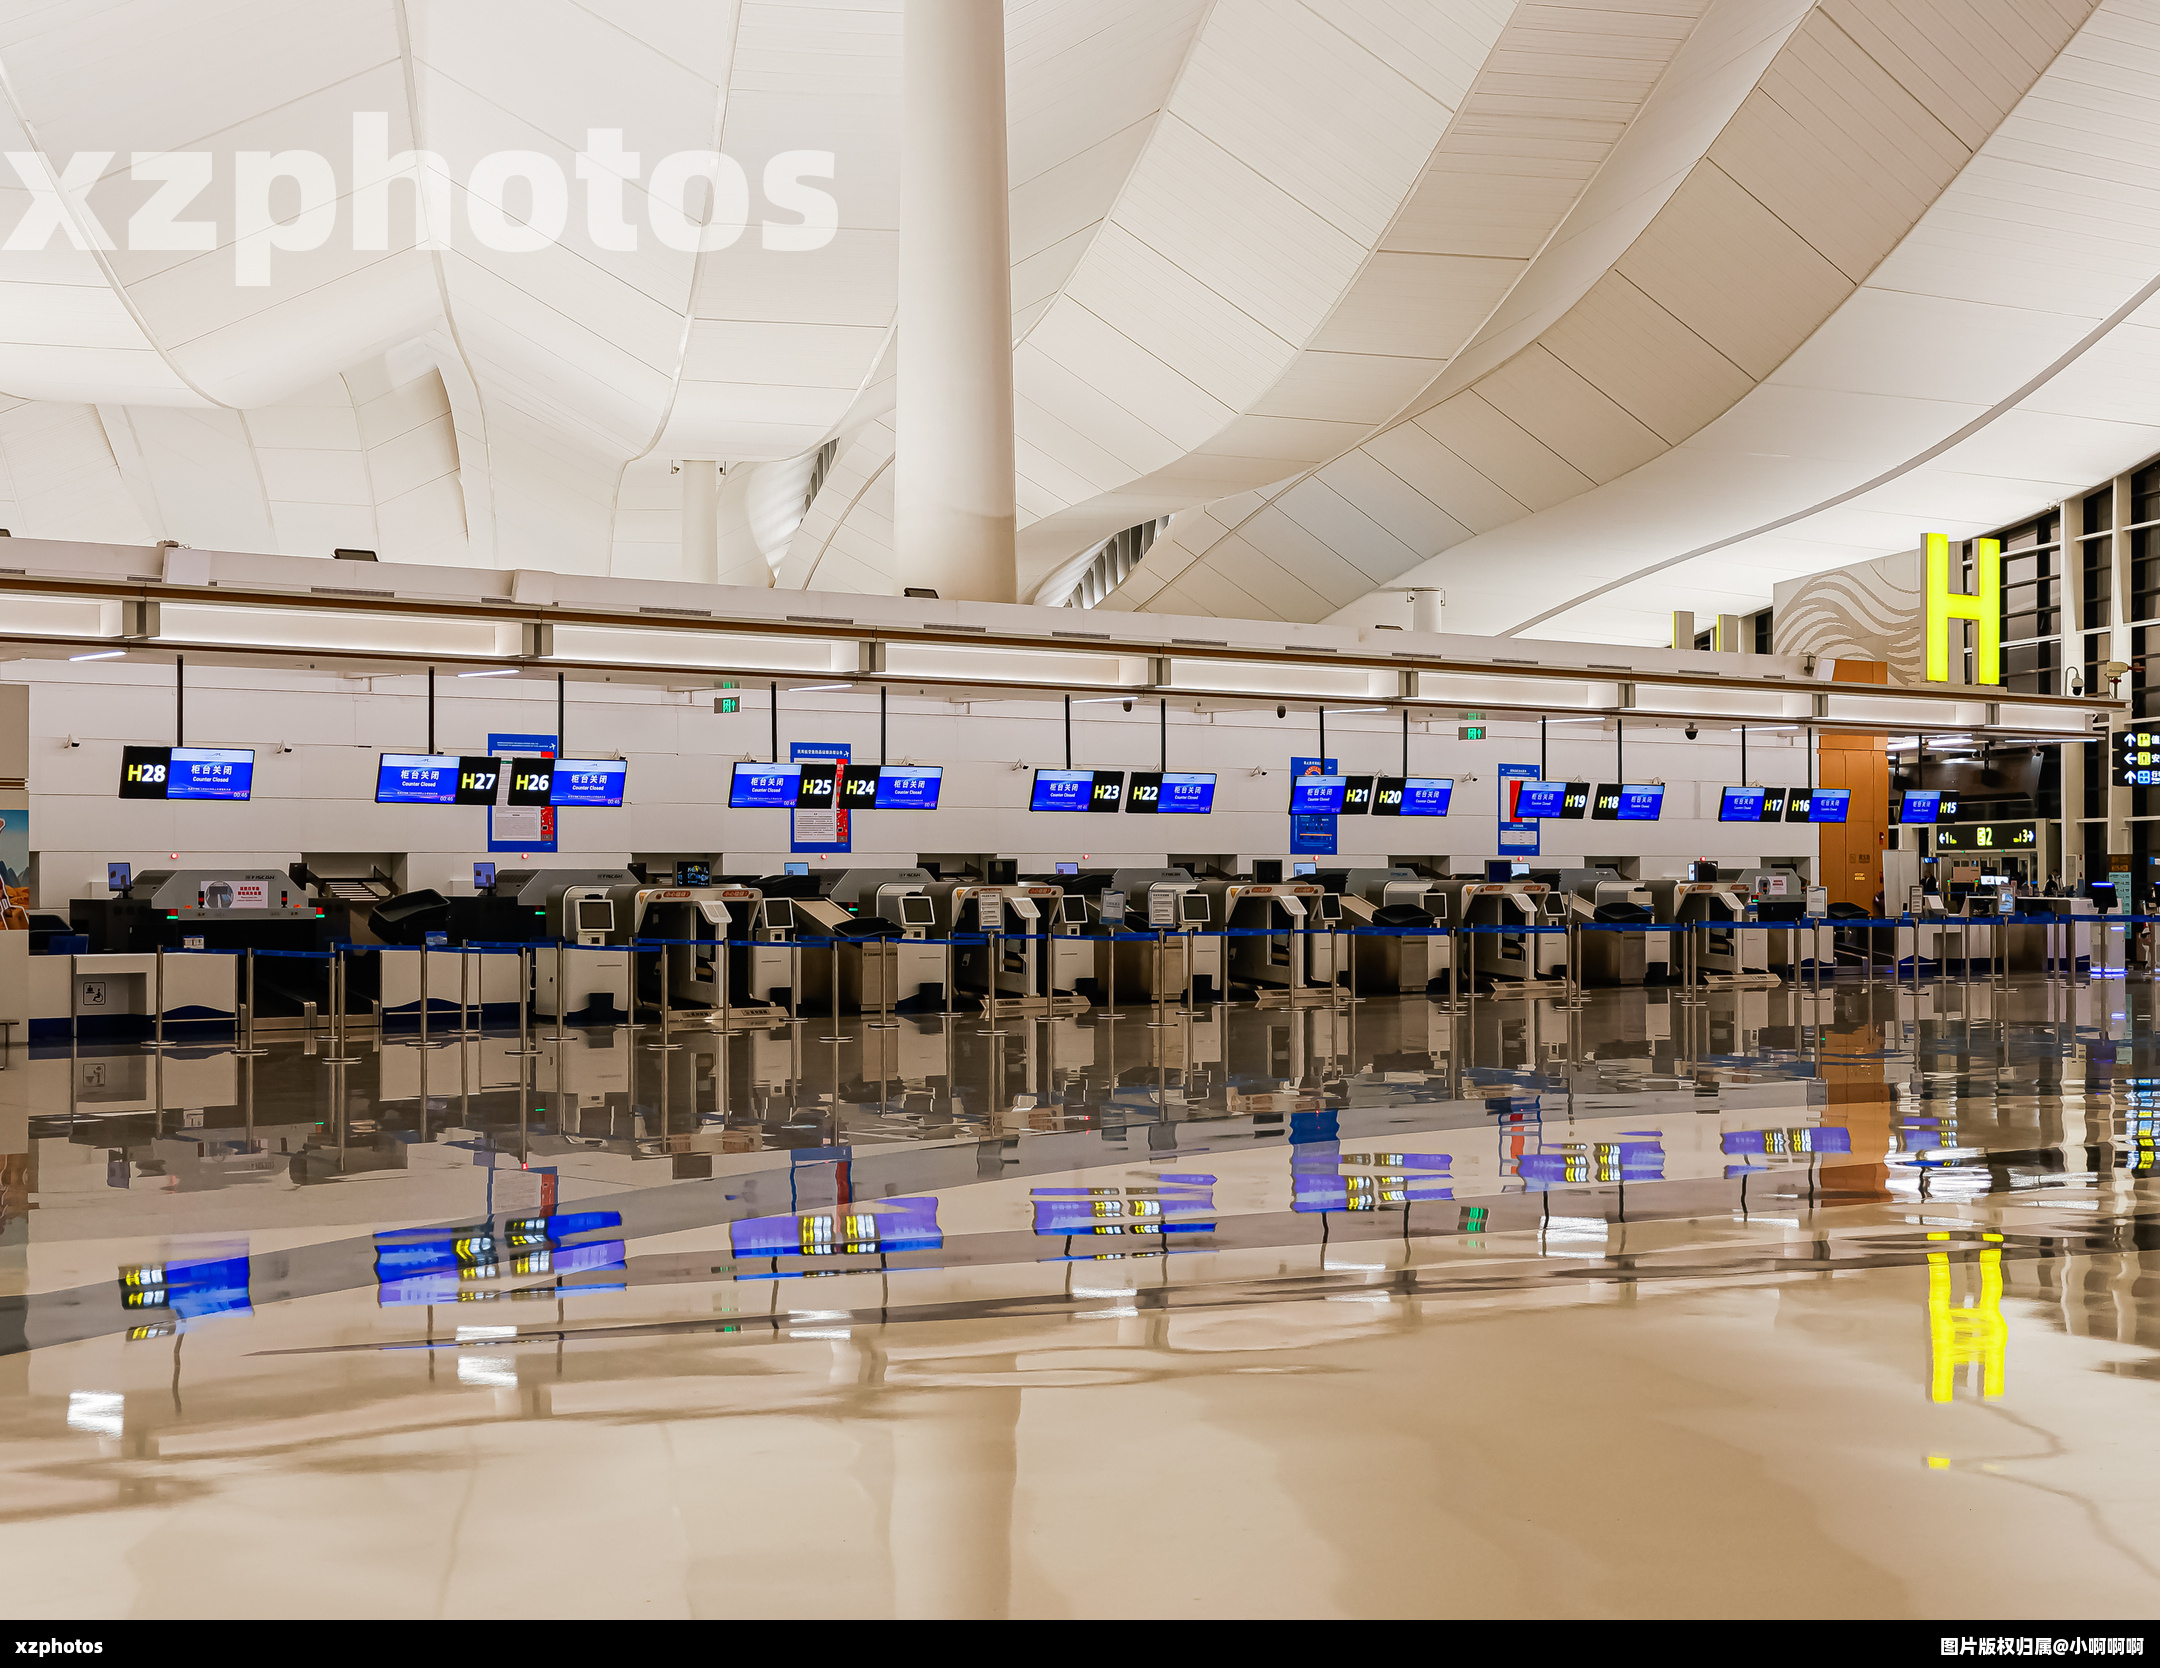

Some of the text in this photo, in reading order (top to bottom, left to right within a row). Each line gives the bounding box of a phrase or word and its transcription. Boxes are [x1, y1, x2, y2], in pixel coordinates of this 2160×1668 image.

[1926, 532, 2000, 685] H
[127, 764, 166, 782] H28
[191, 764, 233, 776] 柜台关闭
[400, 769, 440, 781] 柜台关闭
[461, 772, 497, 790] H27
[515, 774, 549, 791] H26
[570, 774, 608, 785] 柜台关闭
[750, 777, 784, 787] 柜台关闭
[893, 779, 926, 789] 柜台关闭
[802, 779, 832, 795] H25
[846, 779, 875, 796] H24
[1093, 784, 1120, 800] H23
[1132, 786, 1158, 801] H22
[1345, 789, 1369, 803] H21
[1378, 790, 1402, 804] H20
[1564, 794, 1587, 808] H19
[1598, 796, 1620, 809] H18
[1763, 799, 1783, 812] H17
[1791, 800, 1811, 813] H16
[1939, 801, 1958, 814] H15
[1985, 827, 1993, 846] 2
[2022, 829, 2029, 844] 3
